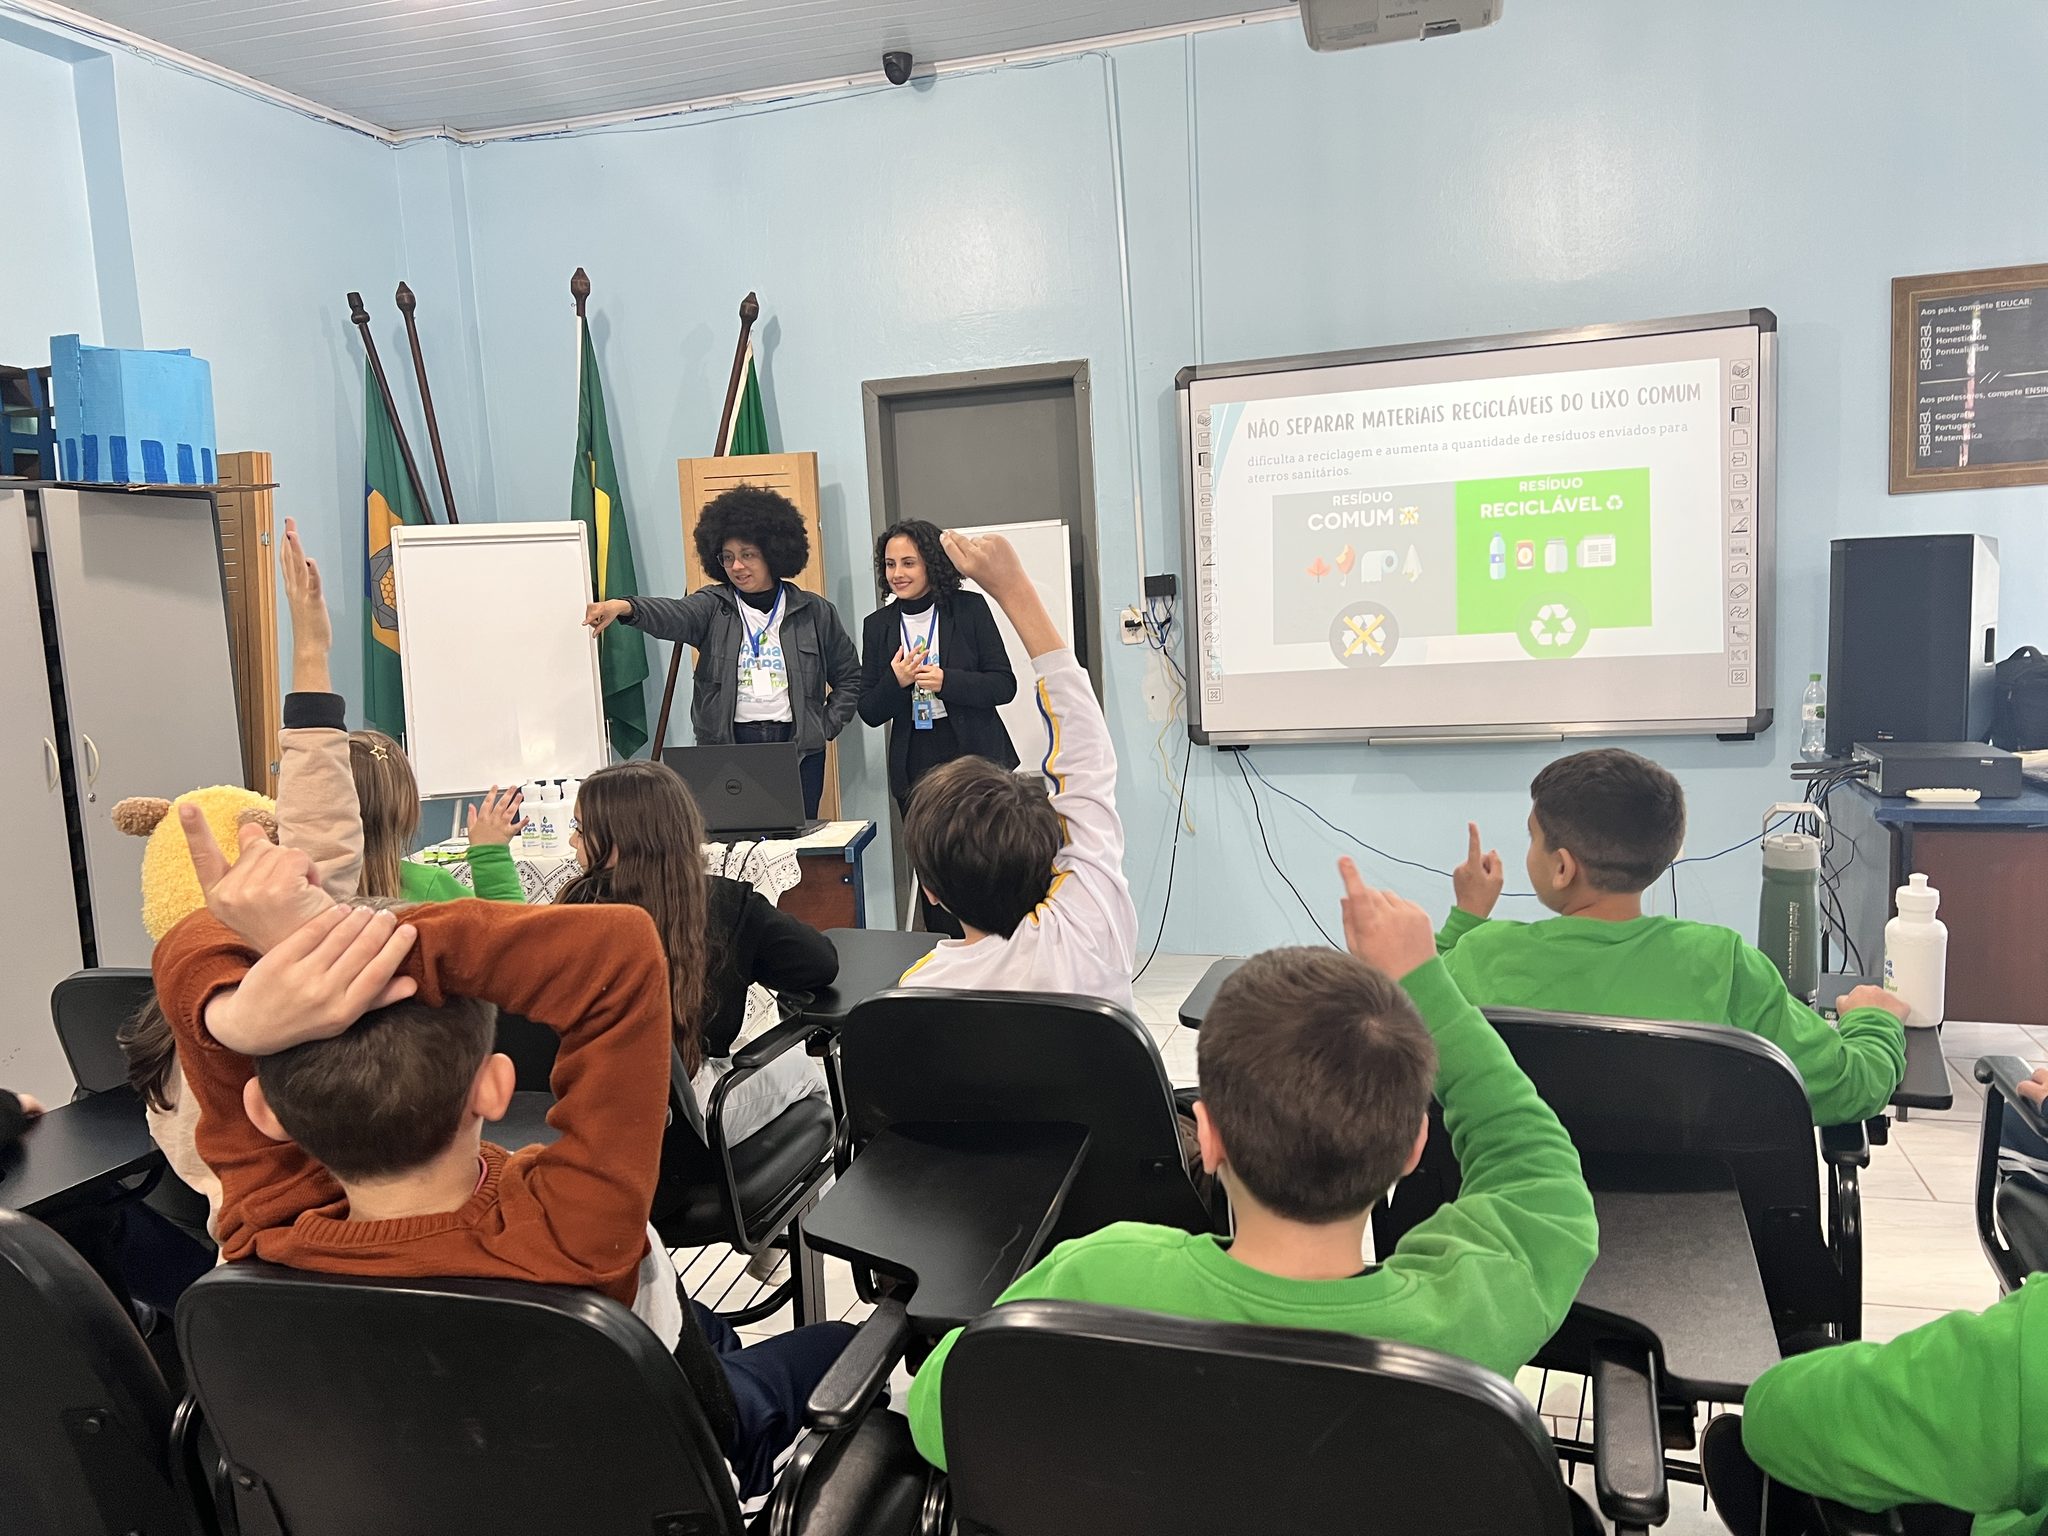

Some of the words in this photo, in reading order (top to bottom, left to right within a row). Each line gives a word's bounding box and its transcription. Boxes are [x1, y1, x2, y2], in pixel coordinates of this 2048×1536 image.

[1921, 308, 1936, 316] Aos
[1938, 305, 1957, 315] pais,
[1958, 302, 1994, 313] compete
[1936, 324, 1971, 334] Respeito
[1936, 334, 1987, 345] Honestidde
[1920, 396, 1935, 404] Aos
[1987, 388, 2023, 399] compete
[1247, 418, 1279, 439] NÃO
[1286, 413, 1355, 436] SEPARAR
[1561, 393, 1584, 412] DO
[1637, 383, 1701, 406] COMUM
[1247, 453, 1295, 467] dificulta
[1298, 455, 1305, 463] a
[1307, 447, 1373, 463] reciclagem
[1375, 448, 1382, 456] e
[1385, 443, 1439, 456] aumenta
[1442, 442, 1448, 451] a
[1451, 433, 1520, 452] quantidade
[1523, 432, 1538, 445] de
[1541, 428, 1596, 443] resíduos
[1598, 424, 1657, 438] enviados
[1659, 423, 1688, 437] para
[1247, 471, 1289, 484] aterros
[1292, 466, 1352, 480] sanitários.
[1519, 476, 1584, 493] RESÍDUO
[1332, 490, 1393, 506] RESÍDUO
[1480, 494, 1602, 519] RECICLÁVEL
[1308, 507, 1394, 531] COMUM
